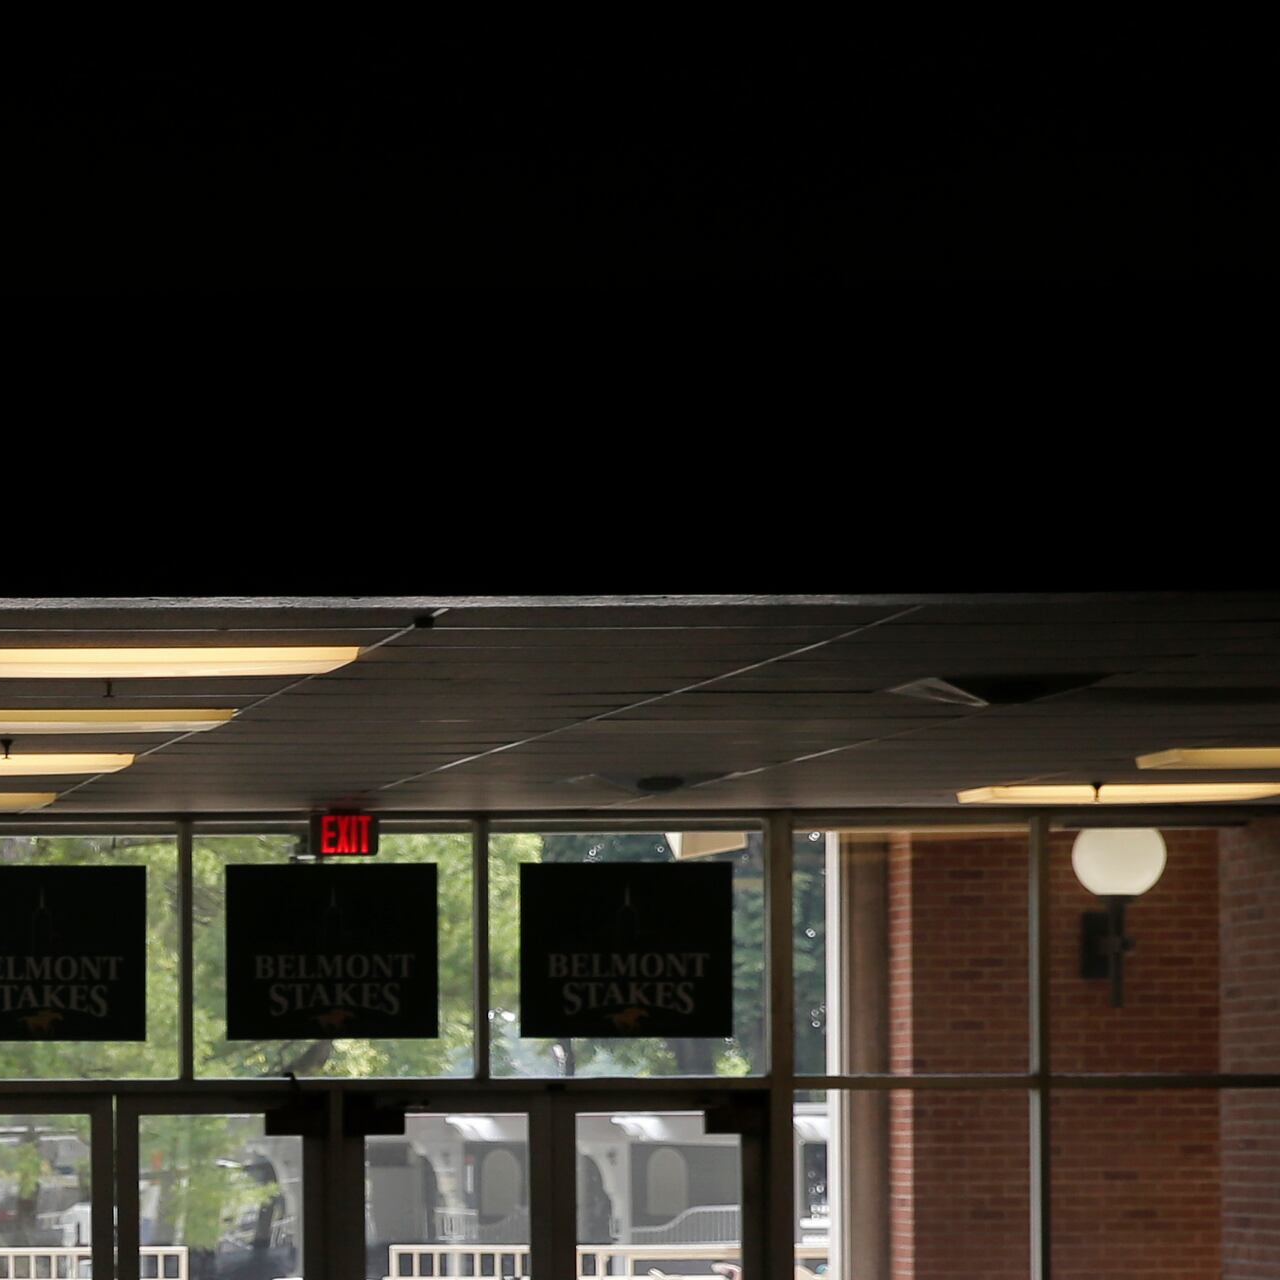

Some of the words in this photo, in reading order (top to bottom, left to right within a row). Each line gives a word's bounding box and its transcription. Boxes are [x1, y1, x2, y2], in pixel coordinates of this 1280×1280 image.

[321, 815, 372, 854] EXIT
[253, 953, 416, 980] BELMONT
[547, 952, 711, 979] BELMONT
[268, 982, 401, 1017] STAKES
[561, 981, 696, 1016] STAKES
